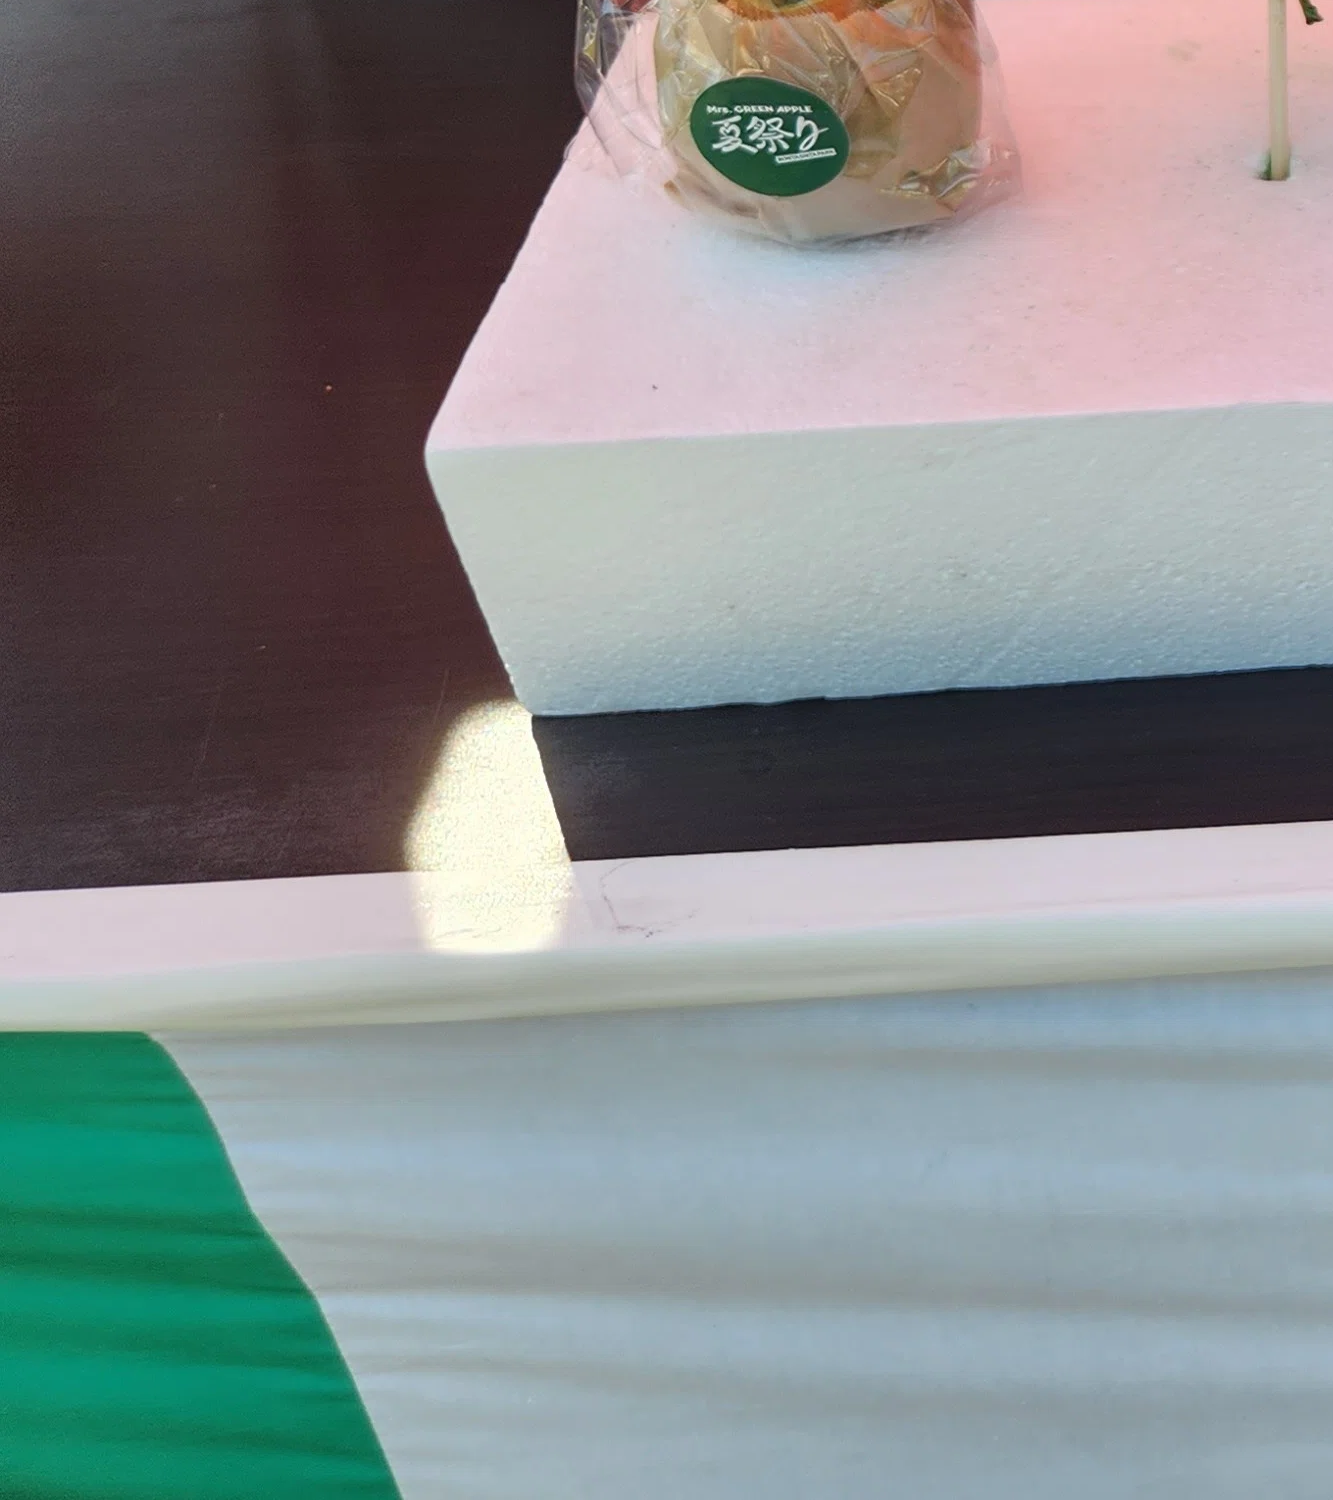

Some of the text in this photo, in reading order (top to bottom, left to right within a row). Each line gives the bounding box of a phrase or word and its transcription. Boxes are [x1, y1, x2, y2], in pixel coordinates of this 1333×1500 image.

[734, 105, 774, 113] GREEN
[776, 105, 813, 113] APPLE
[711, 115, 830, 155] 夏祭り
